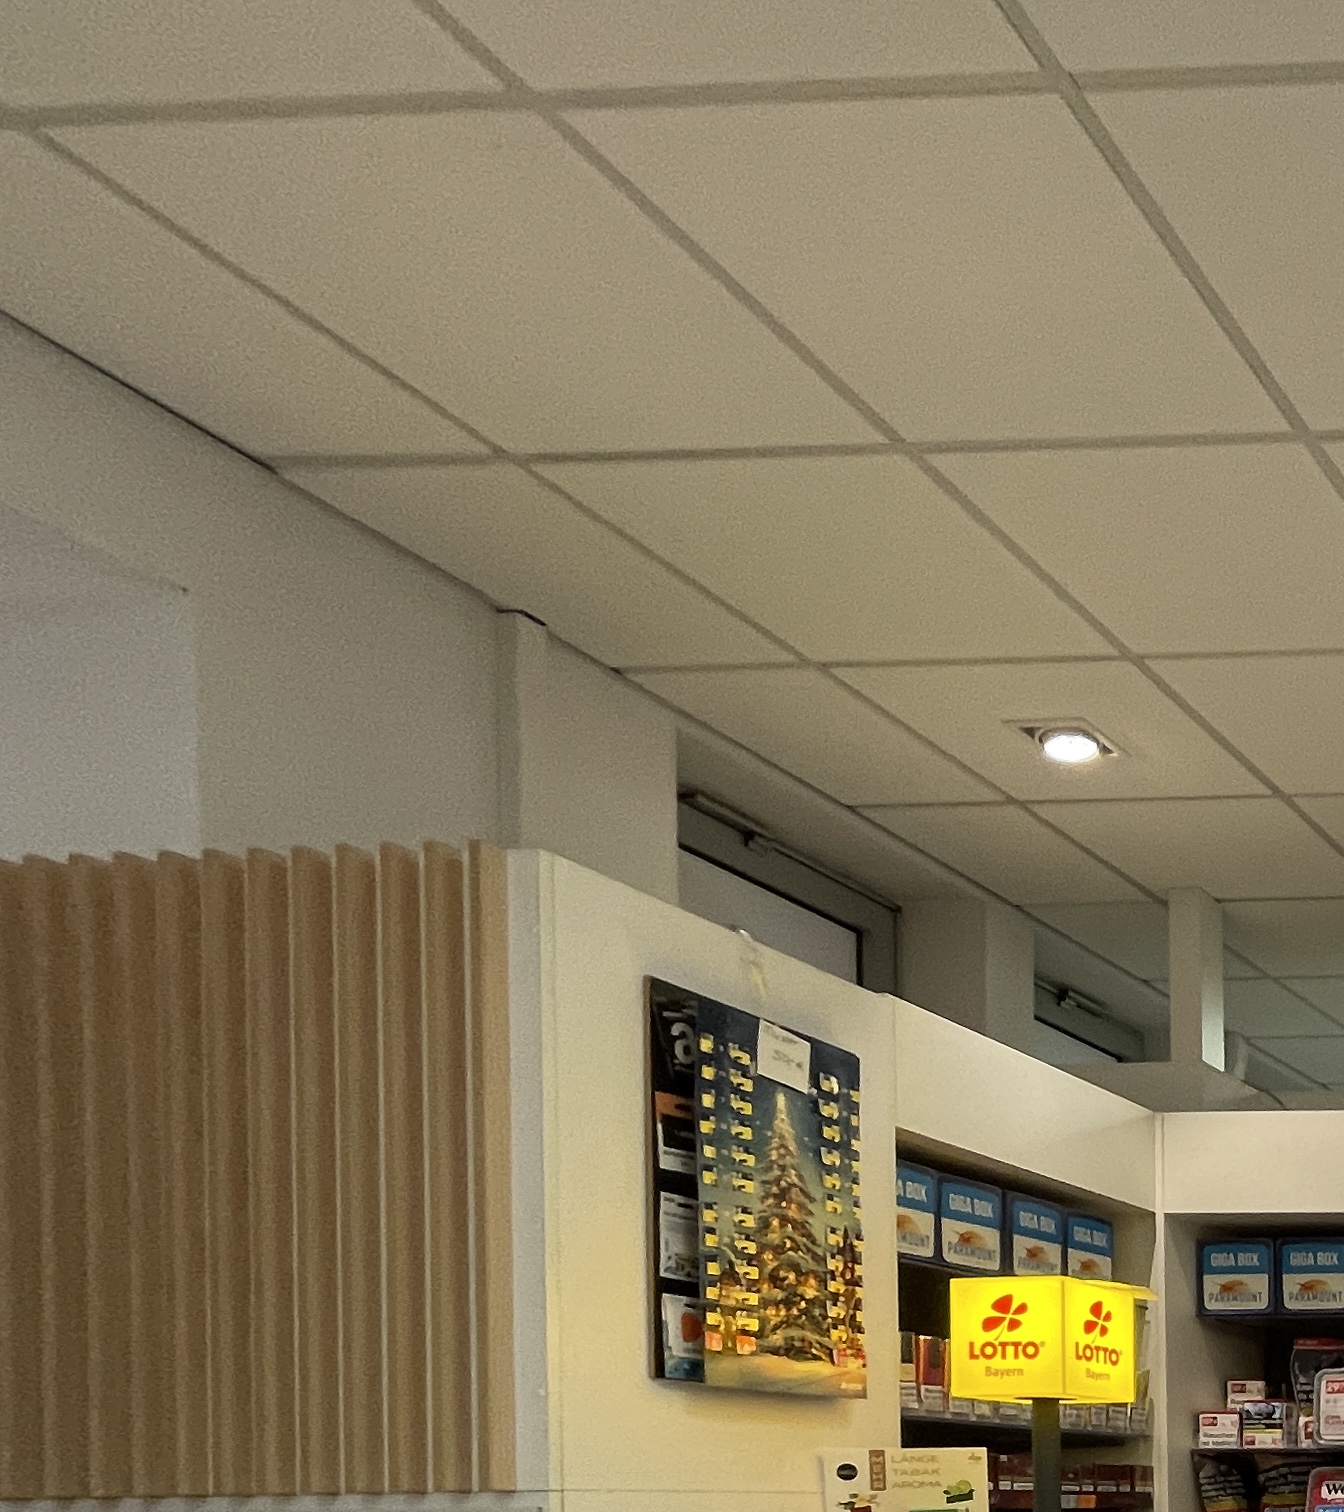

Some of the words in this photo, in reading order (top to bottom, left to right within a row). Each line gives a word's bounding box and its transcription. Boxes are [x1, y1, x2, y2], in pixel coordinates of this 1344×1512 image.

[969, 1341, 1040, 1360] LOTTO
[1075, 1342, 1120, 1367] LOTTO
[985, 1366, 1024, 1379] Bayern
[1086, 1370, 1110, 1381] Bayern
